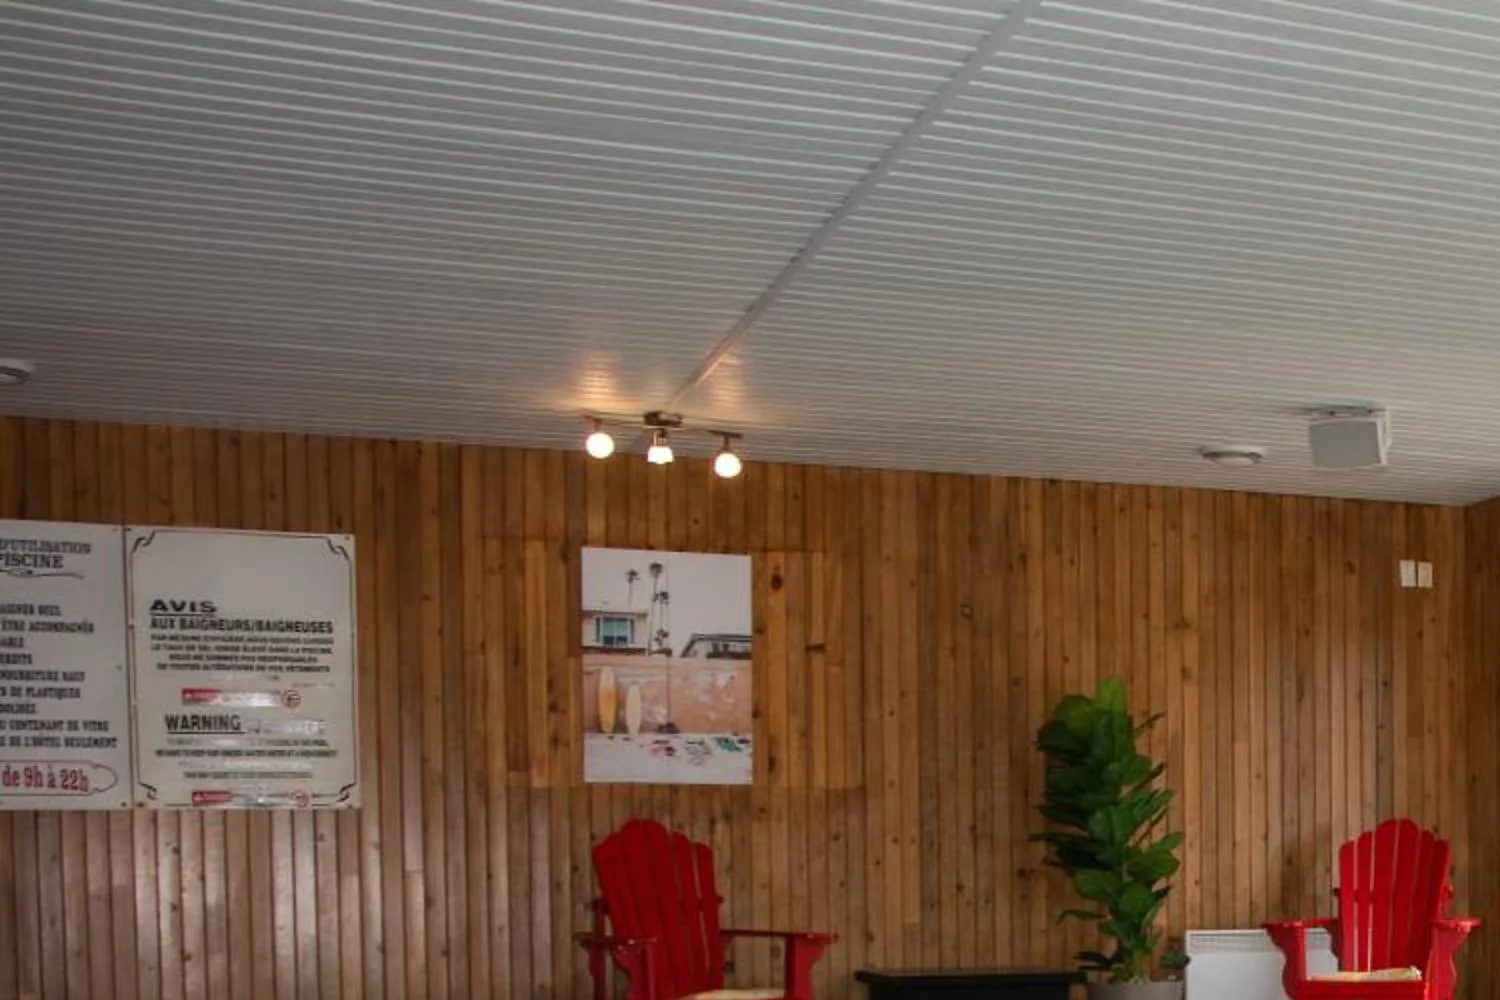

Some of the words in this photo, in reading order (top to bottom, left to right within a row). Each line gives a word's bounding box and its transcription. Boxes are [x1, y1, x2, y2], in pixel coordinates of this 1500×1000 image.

[149, 600, 217, 613] AVIS
[150, 617, 176, 630] AUX
[165, 714, 241, 731] WARNING
[2, 764, 20, 788] de
[60, 768, 90, 793] 22h
